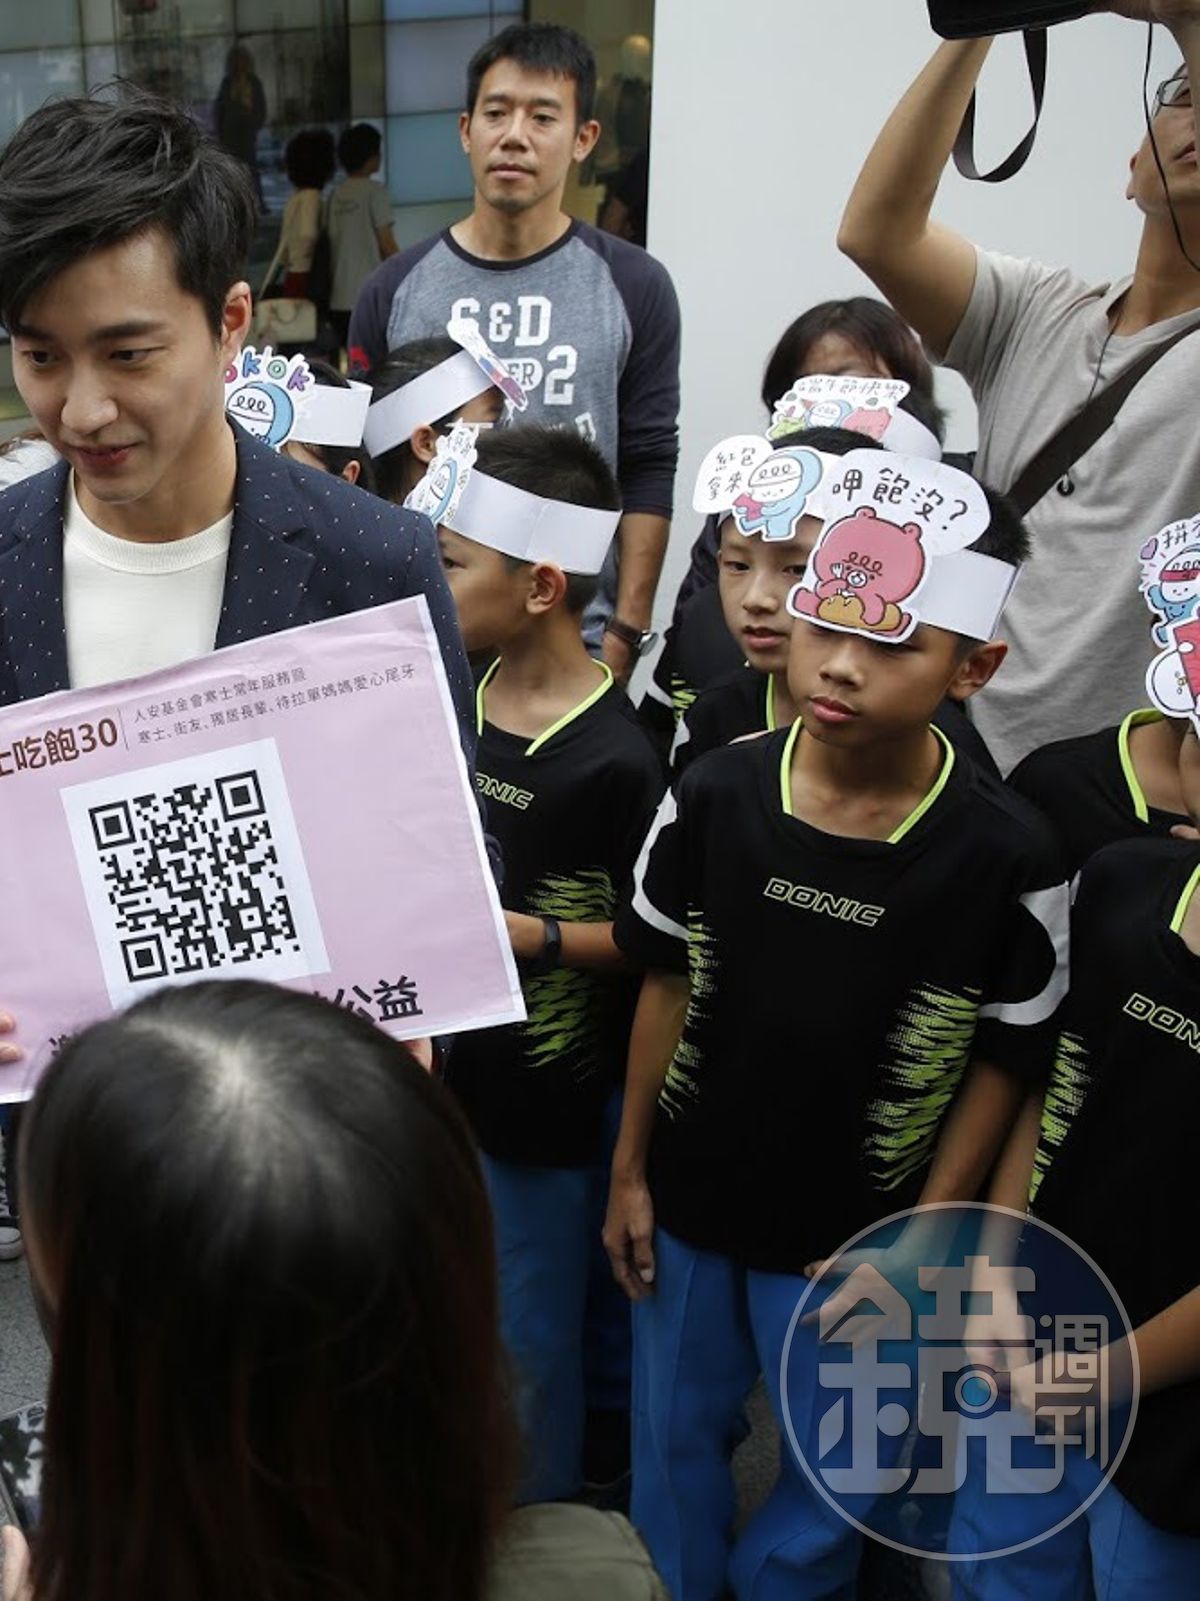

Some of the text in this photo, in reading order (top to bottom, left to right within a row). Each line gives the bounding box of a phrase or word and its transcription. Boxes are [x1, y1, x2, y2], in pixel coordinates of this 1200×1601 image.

[544, 345, 577, 405] 2
[716, 447, 756, 472] 紅包
[707, 472, 743, 500] 拿來
[475, 772, 535, 810] ONIC
[763, 877, 886, 927] DONIC
[314, 975, 424, 1023] 公益
[1123, 992, 1200, 1053] DON
